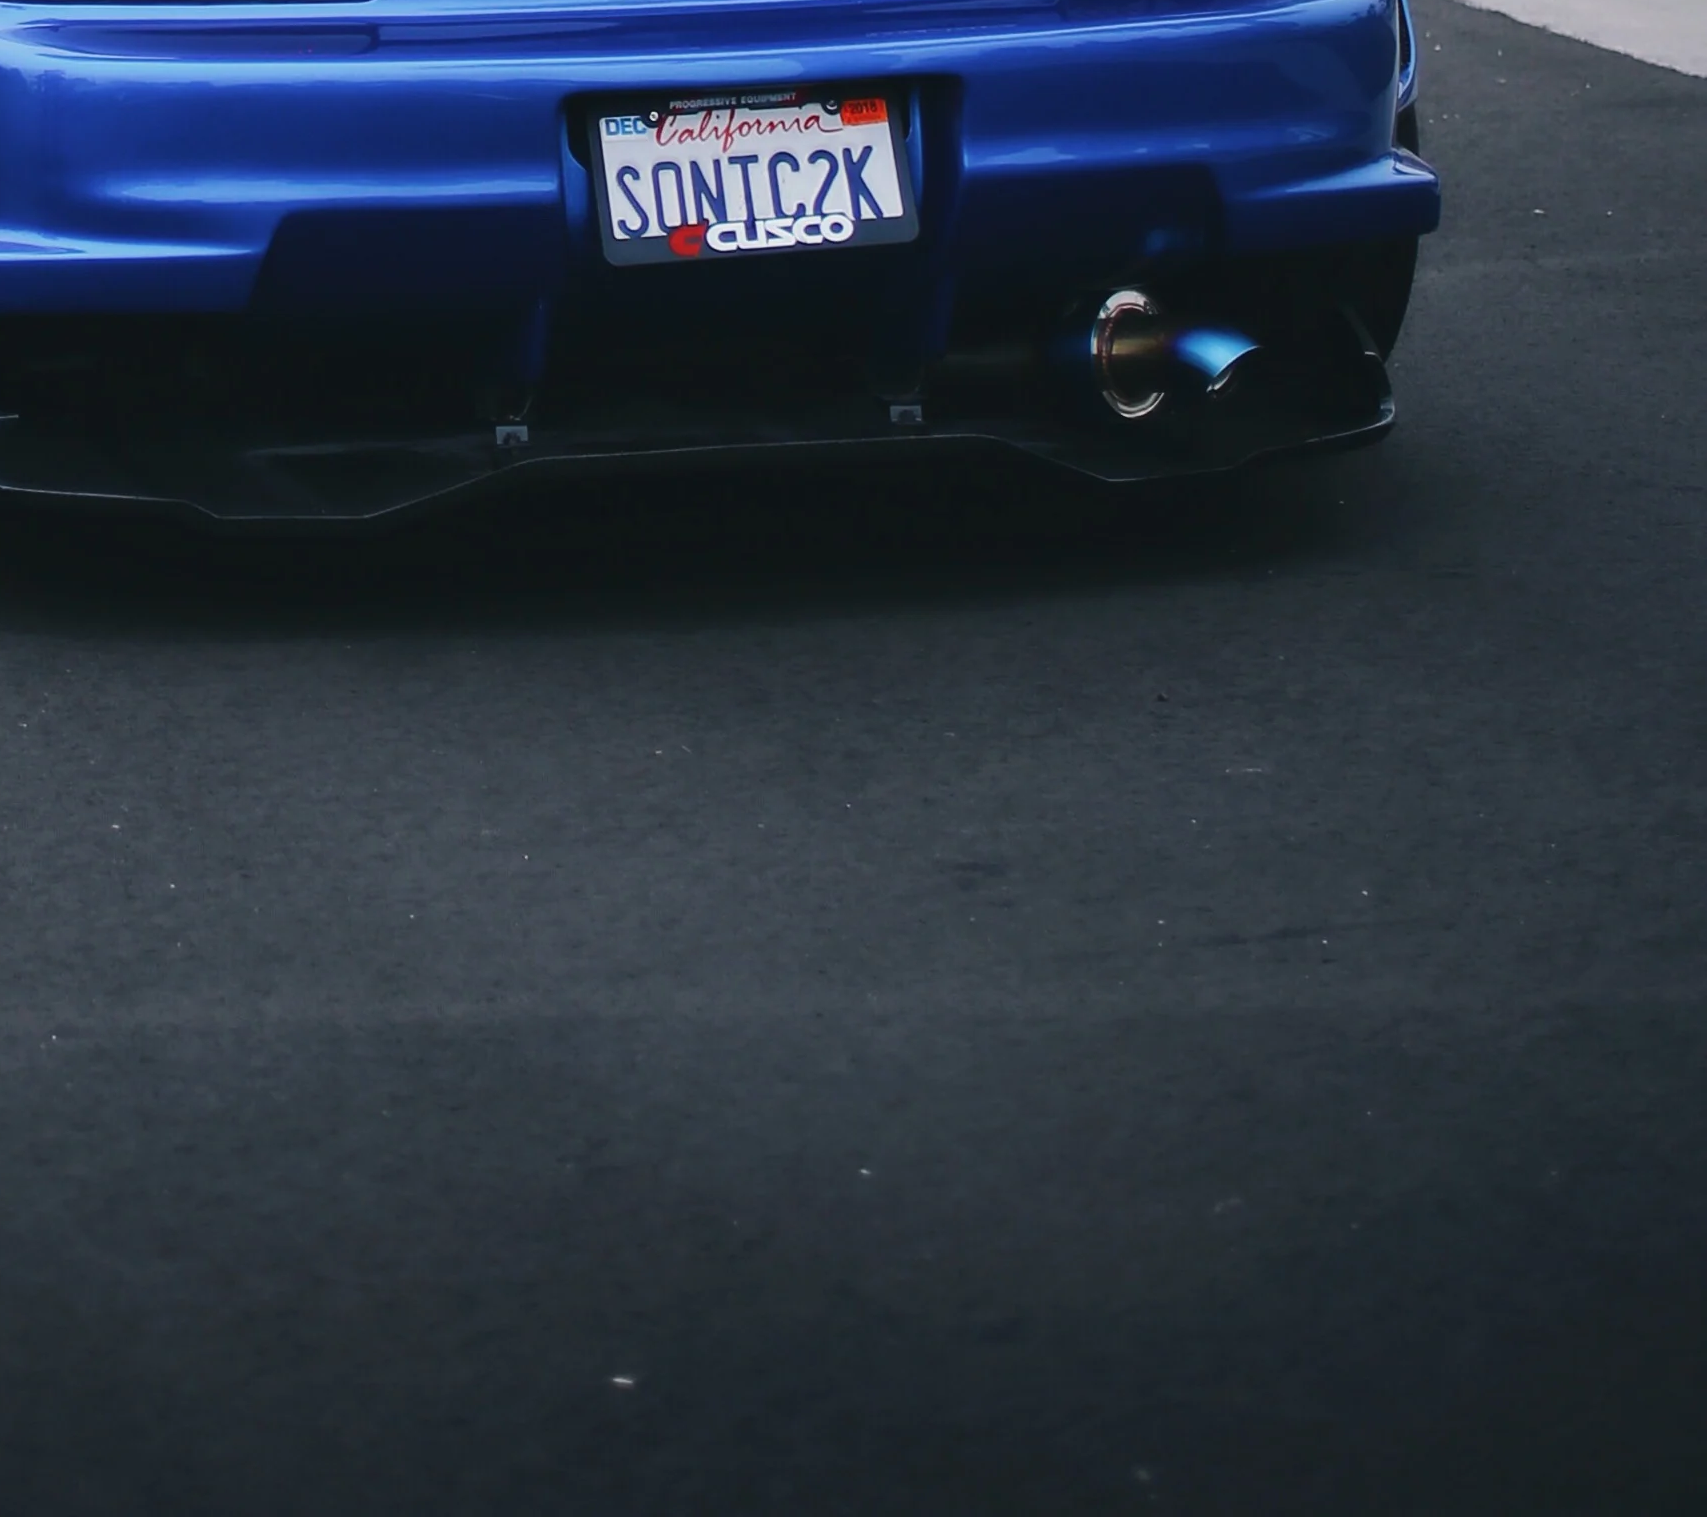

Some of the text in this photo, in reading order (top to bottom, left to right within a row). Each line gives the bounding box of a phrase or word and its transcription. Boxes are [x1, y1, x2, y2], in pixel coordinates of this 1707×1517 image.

[669, 92, 797, 110] PROGRESSIVE EQUIPMENT
[605, 116, 647, 136] DEC
[655, 106, 843, 153] California
[616, 145, 884, 238] SONIC2K
[705, 214, 854, 252] CUSCO
